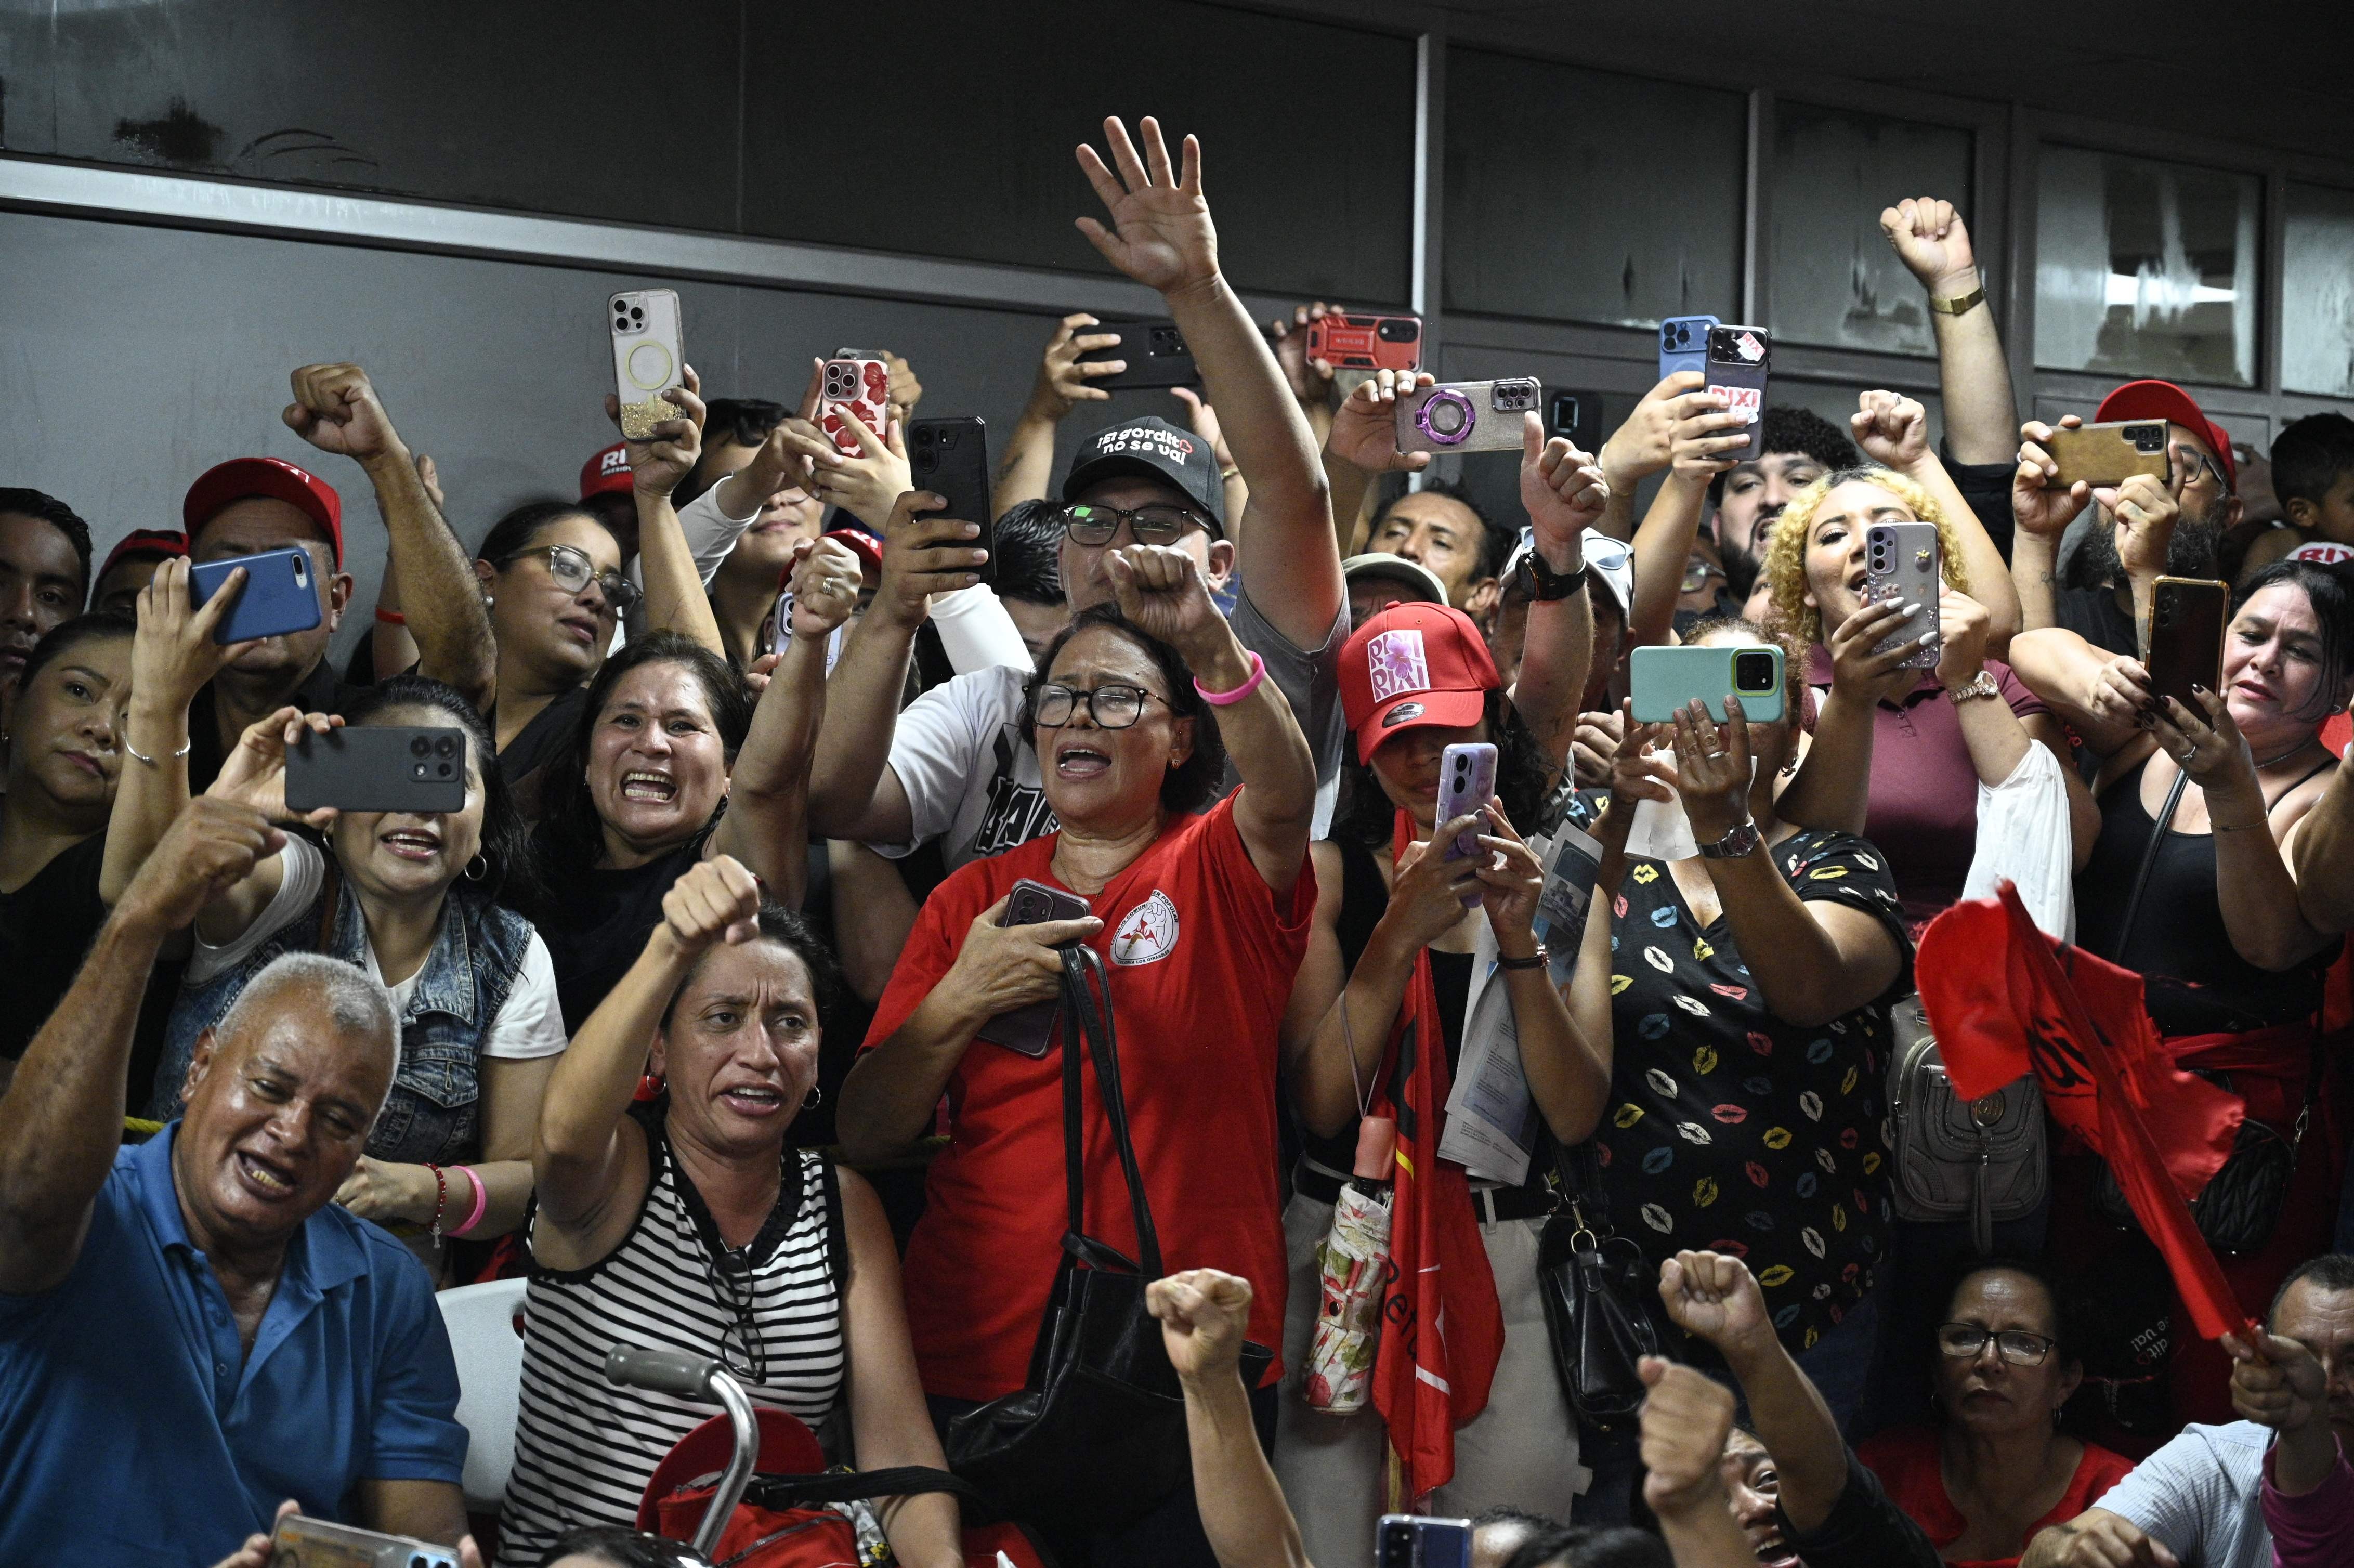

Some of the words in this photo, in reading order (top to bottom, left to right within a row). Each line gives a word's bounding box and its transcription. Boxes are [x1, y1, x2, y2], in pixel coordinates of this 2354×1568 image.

[601, 448, 627, 470] RI
[1103, 441, 1126, 454] no
[1129, 440, 1154, 451] se
[1158, 443, 1186, 465] va!
[1126, 903, 1148, 919] COMUN
[1161, 896, 1179, 923] POPULAR
[1147, 949, 1170, 962] GIRASOLES
